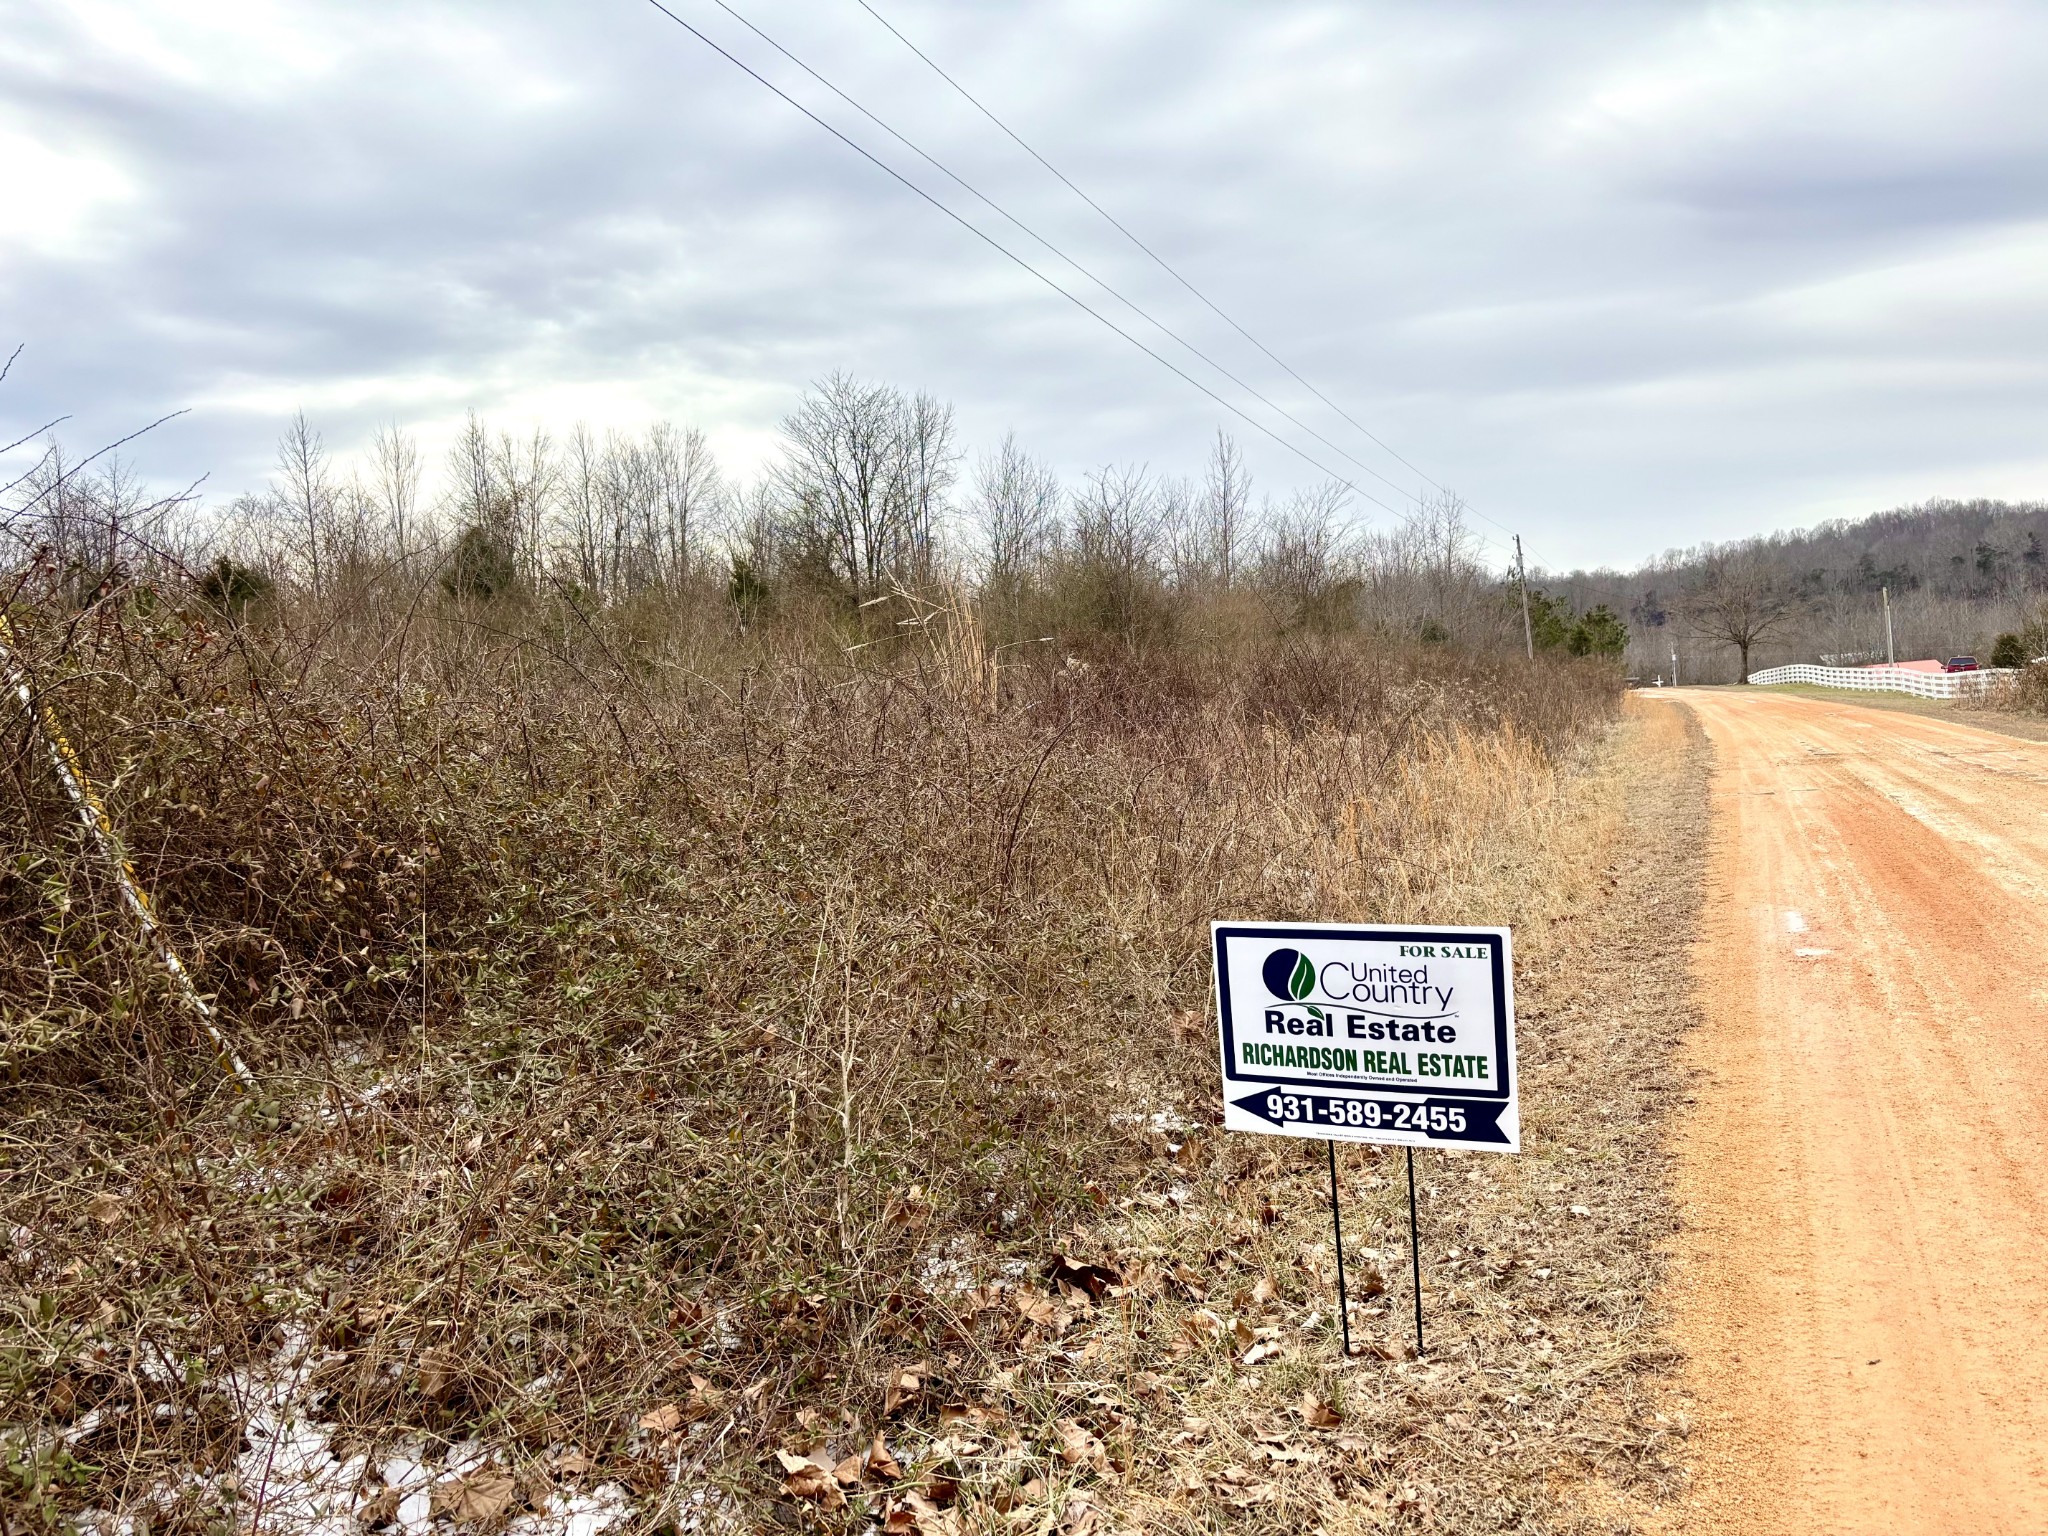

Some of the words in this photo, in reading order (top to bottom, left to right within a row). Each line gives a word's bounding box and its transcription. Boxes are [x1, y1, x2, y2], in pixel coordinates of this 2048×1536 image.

[1400, 945, 1436, 958] FOR
[1441, 946, 1488, 959] SALE
[1320, 961, 1454, 1011] Country
[1351, 962, 1428, 984] United
[1265, 1010, 1334, 1037] Real
[1347, 1014, 1457, 1043] Estate
[1242, 1042, 1357, 1072] RICHARDSON
[1364, 1050, 1411, 1075] REAL
[1418, 1053, 1489, 1079] ESTATE
[1266, 1094, 1467, 1132] 931-589-2455
